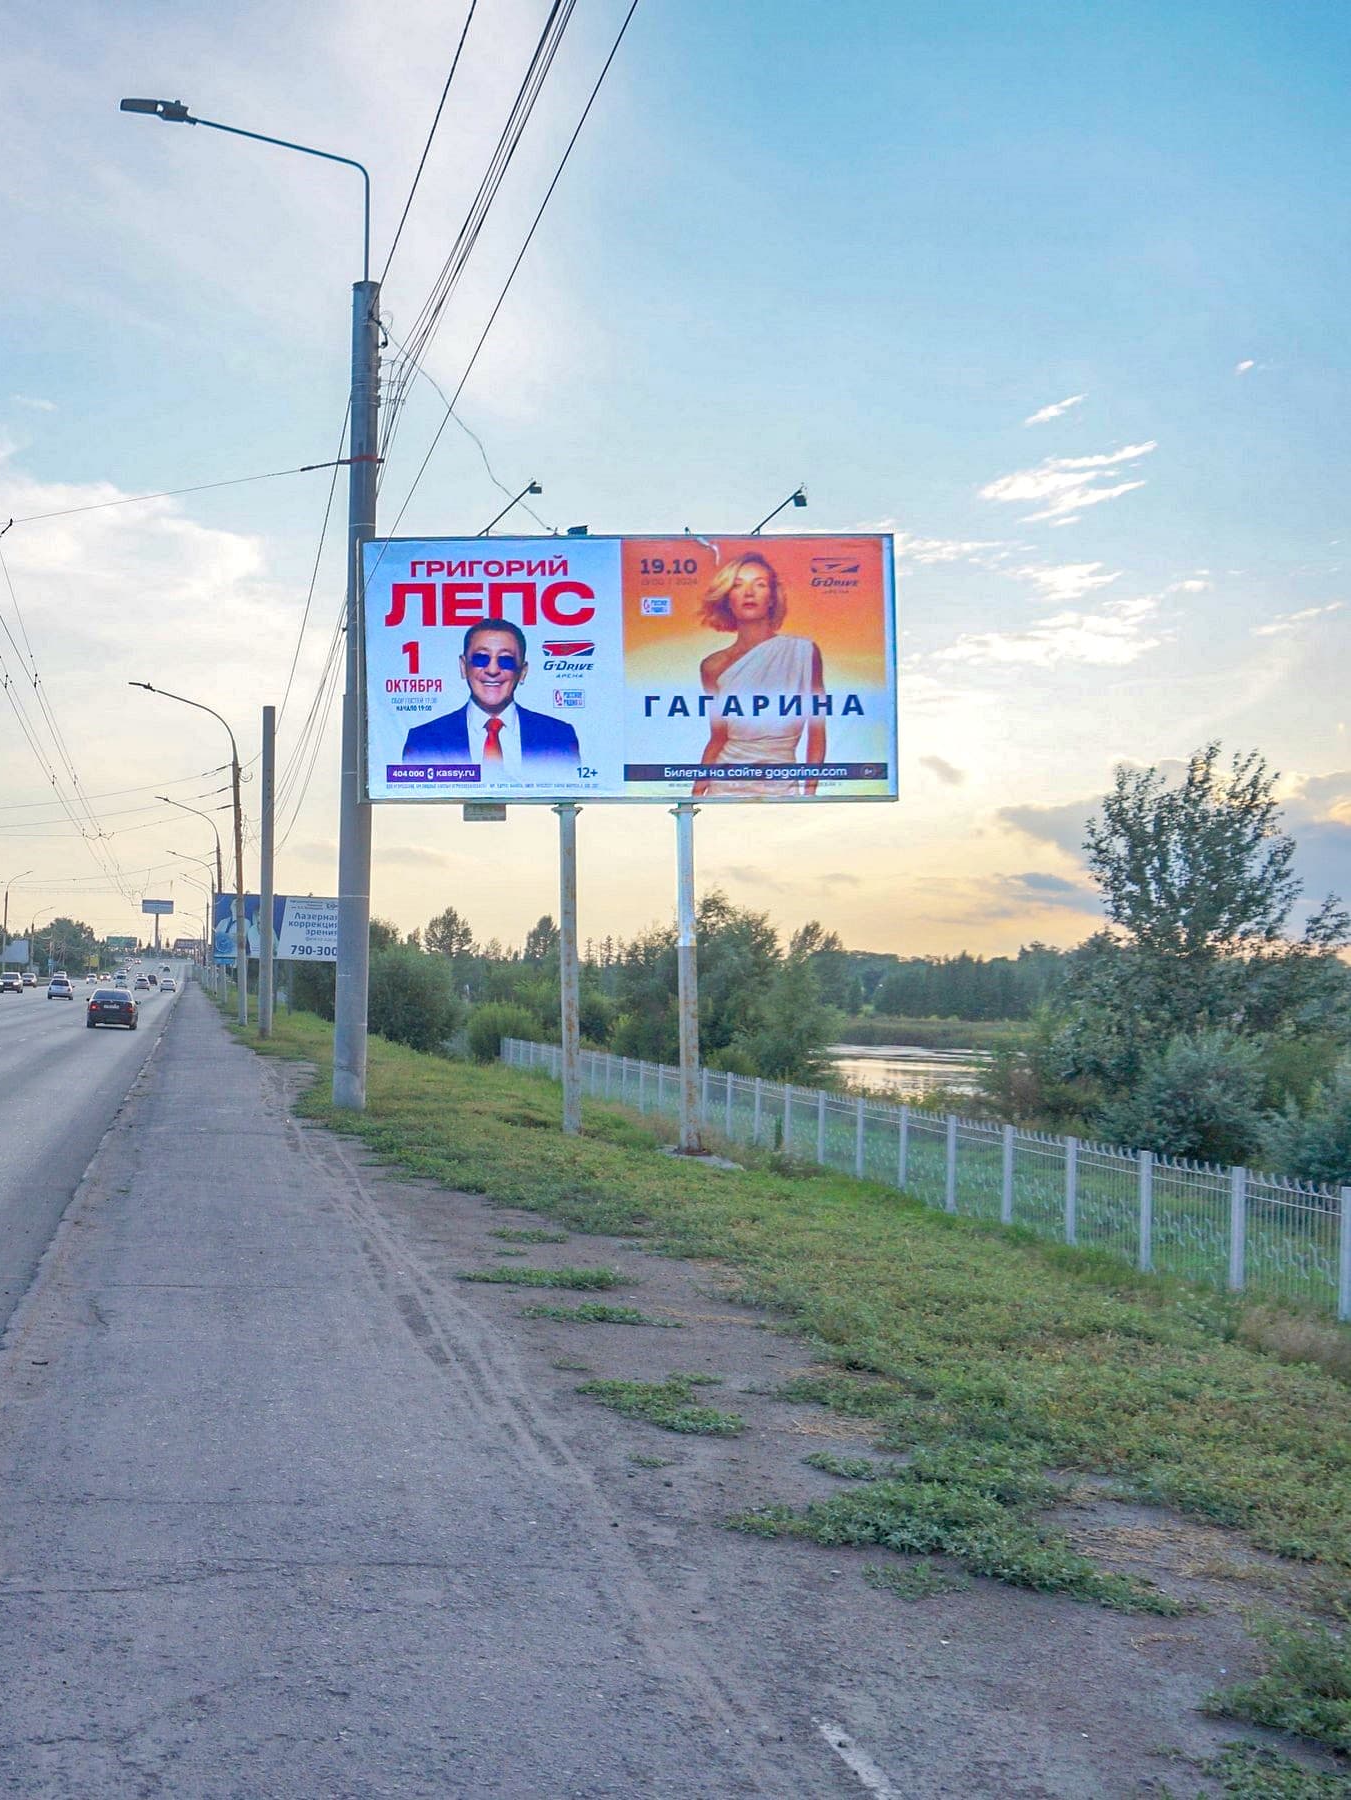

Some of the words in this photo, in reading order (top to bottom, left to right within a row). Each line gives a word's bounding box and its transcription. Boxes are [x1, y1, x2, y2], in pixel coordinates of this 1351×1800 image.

[410, 555, 568, 577] ГРИГОРИЙ
[640, 559, 698, 574] 19.10
[384, 581, 595, 627] ЛЕПС
[402, 641, 420, 675] 1
[385, 679, 442, 693] ОКТЯБРЯ
[644, 694, 865, 717] ГАГАРИНА
[436, 769, 475, 778] kassy.ru
[577, 767, 598, 778] 12+
[664, 767, 707, 777] Билеты
[710, 769, 725, 777] на
[728, 767, 762, 777] сайте
[765, 767, 847, 779] gagarina.com
[291, 945, 337, 956] 790-300
